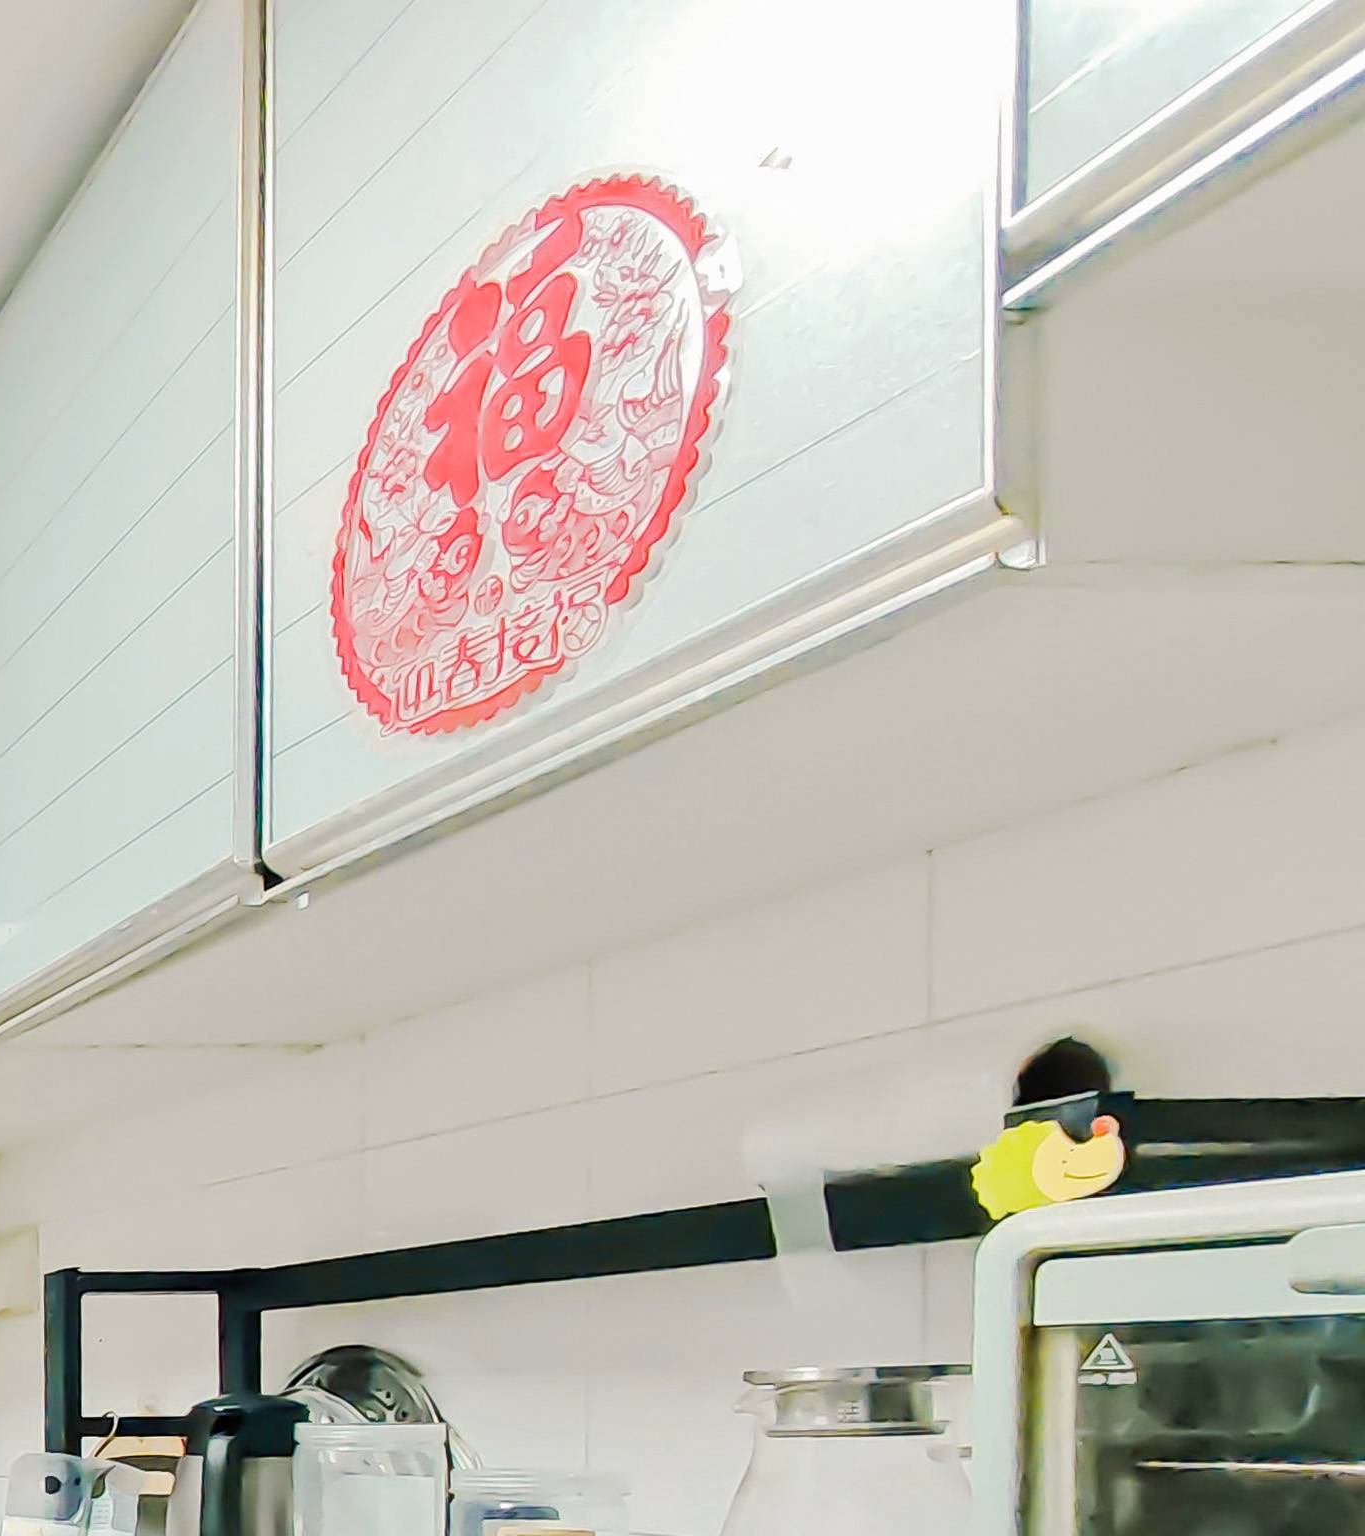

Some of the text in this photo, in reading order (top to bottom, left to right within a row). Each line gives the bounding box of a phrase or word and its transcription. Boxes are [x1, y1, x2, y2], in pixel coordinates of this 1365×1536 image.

[422, 208, 591, 508] 福
[386, 567, 610, 729] 迎春接福
